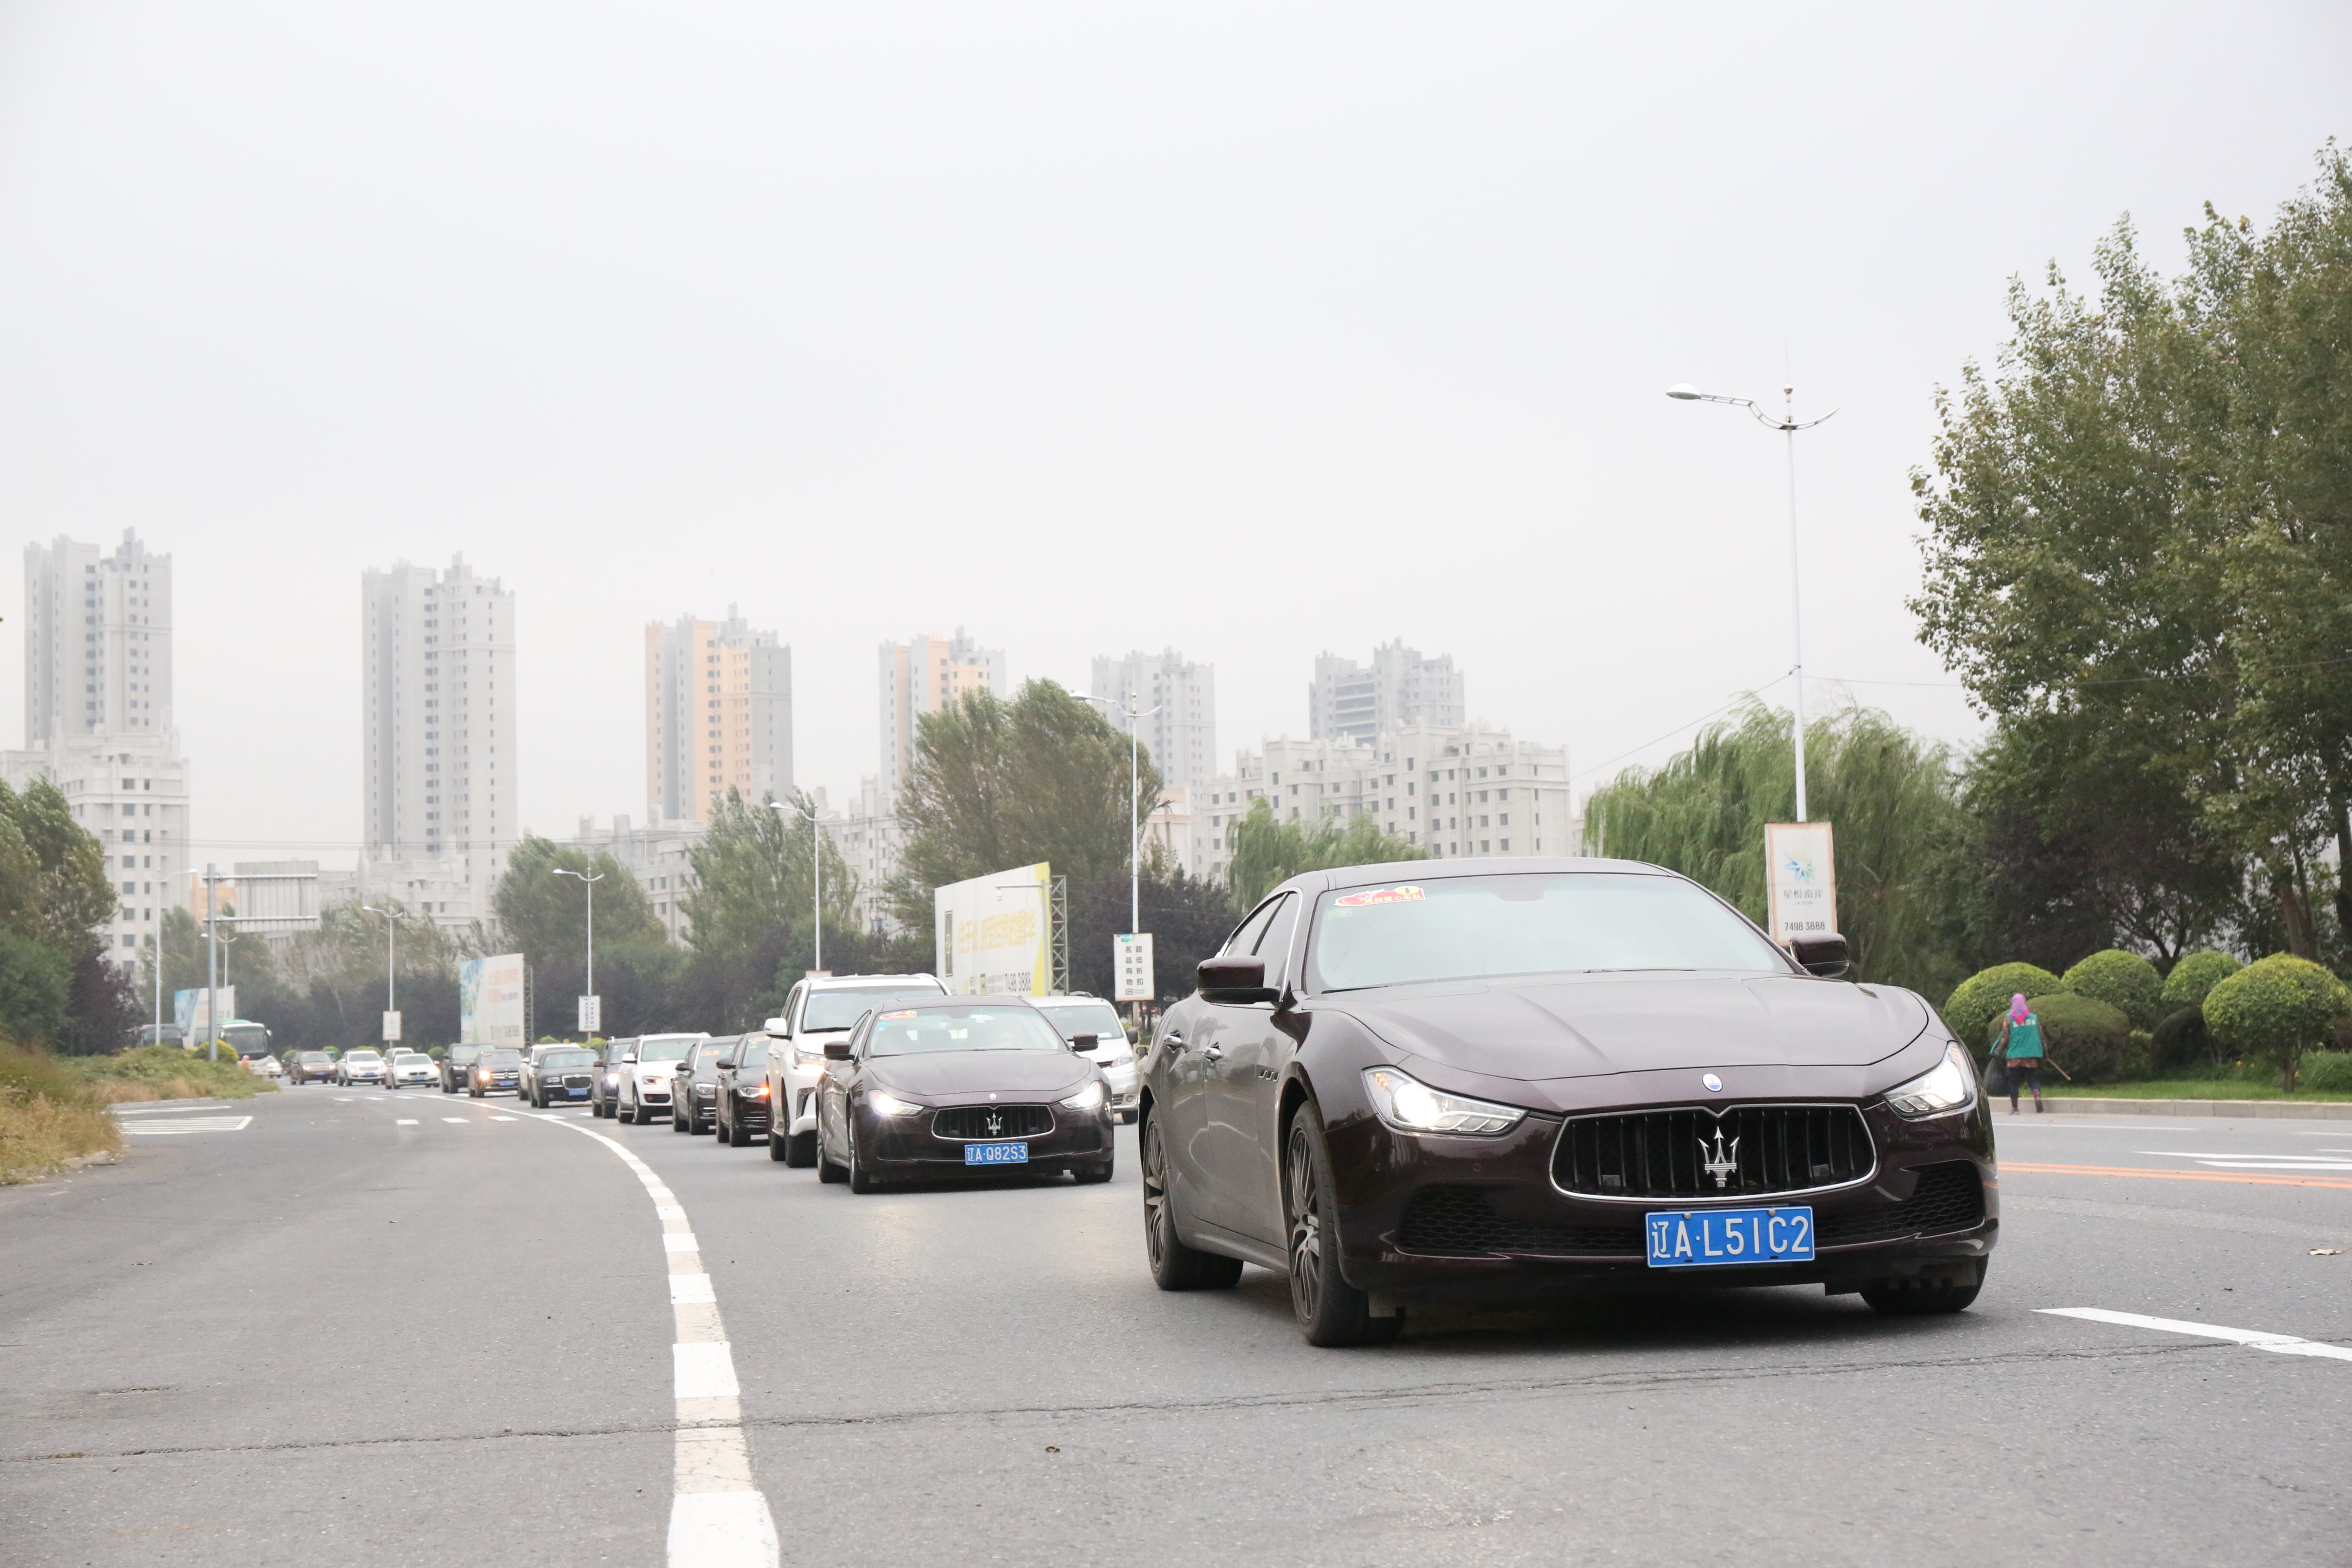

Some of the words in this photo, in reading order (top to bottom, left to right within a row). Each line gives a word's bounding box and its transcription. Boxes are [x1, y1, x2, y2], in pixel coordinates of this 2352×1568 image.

[1784, 889, 1823, 899] 星悦南岸
[1784, 922, 1803, 931] 7498
[1805, 921, 1825, 931] 3888
